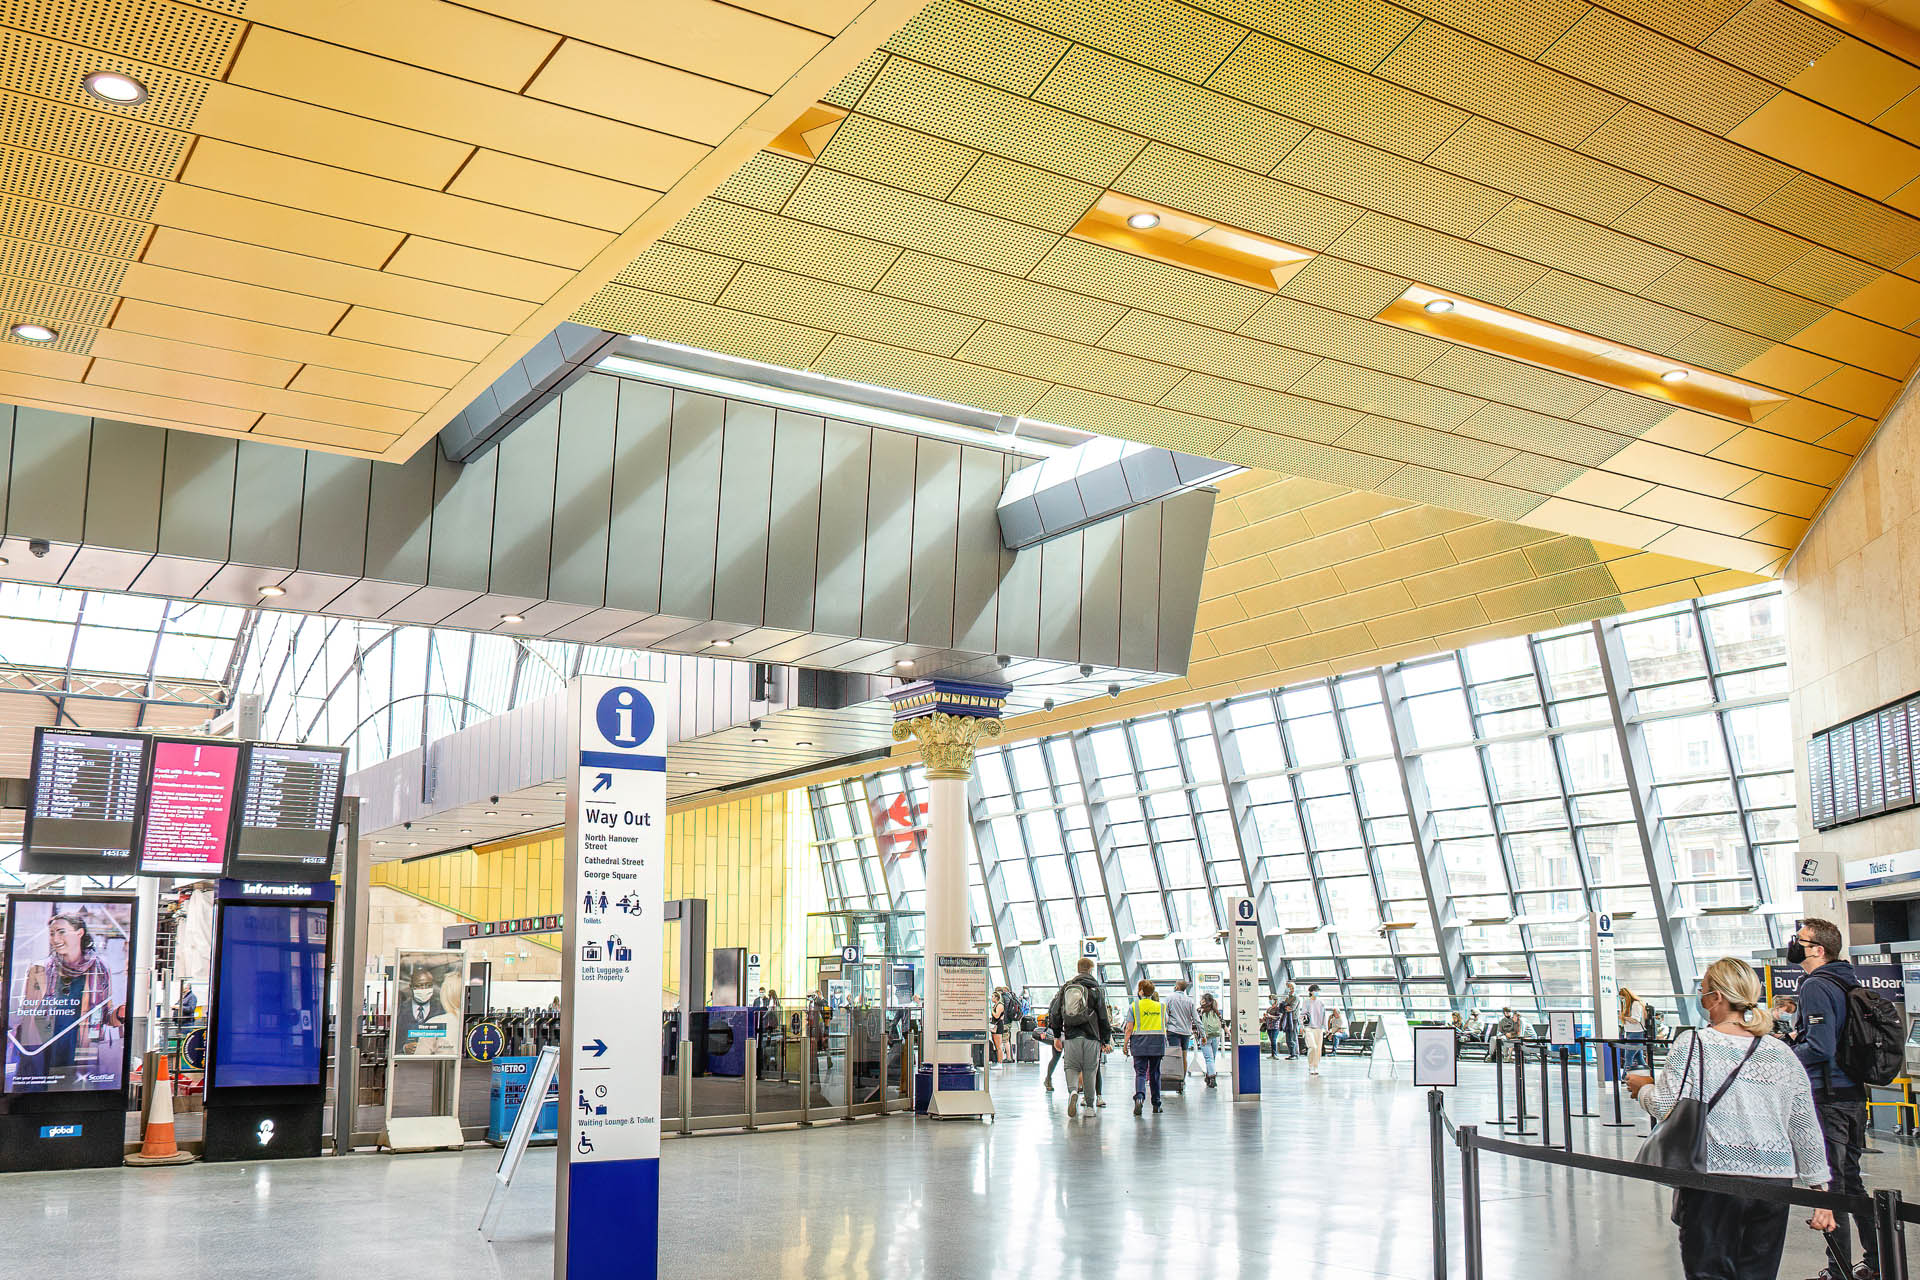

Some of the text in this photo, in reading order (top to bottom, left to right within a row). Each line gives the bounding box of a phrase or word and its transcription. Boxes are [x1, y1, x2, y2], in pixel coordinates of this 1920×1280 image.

[586, 808, 651, 828] Way Out
[585, 833, 639, 844] North Hanover
[584, 842, 608, 850] Street
[584, 856, 644, 866] Cathedral Street
[1869, 861, 1887, 874] Tickets
[584, 870, 638, 880] George Square
[242, 882, 312, 896] Information
[597, 967, 622, 975] Luggage
[597, 974, 624, 982] Property
[1774, 976, 1799, 992] Buy
[17, 1008, 76, 1016] better times
[578, 1119, 602, 1127] Waiting
[605, 1118, 628, 1126] Lounge
[637, 1116, 654, 1124] Toilet
[50, 1126, 74, 1138] global
